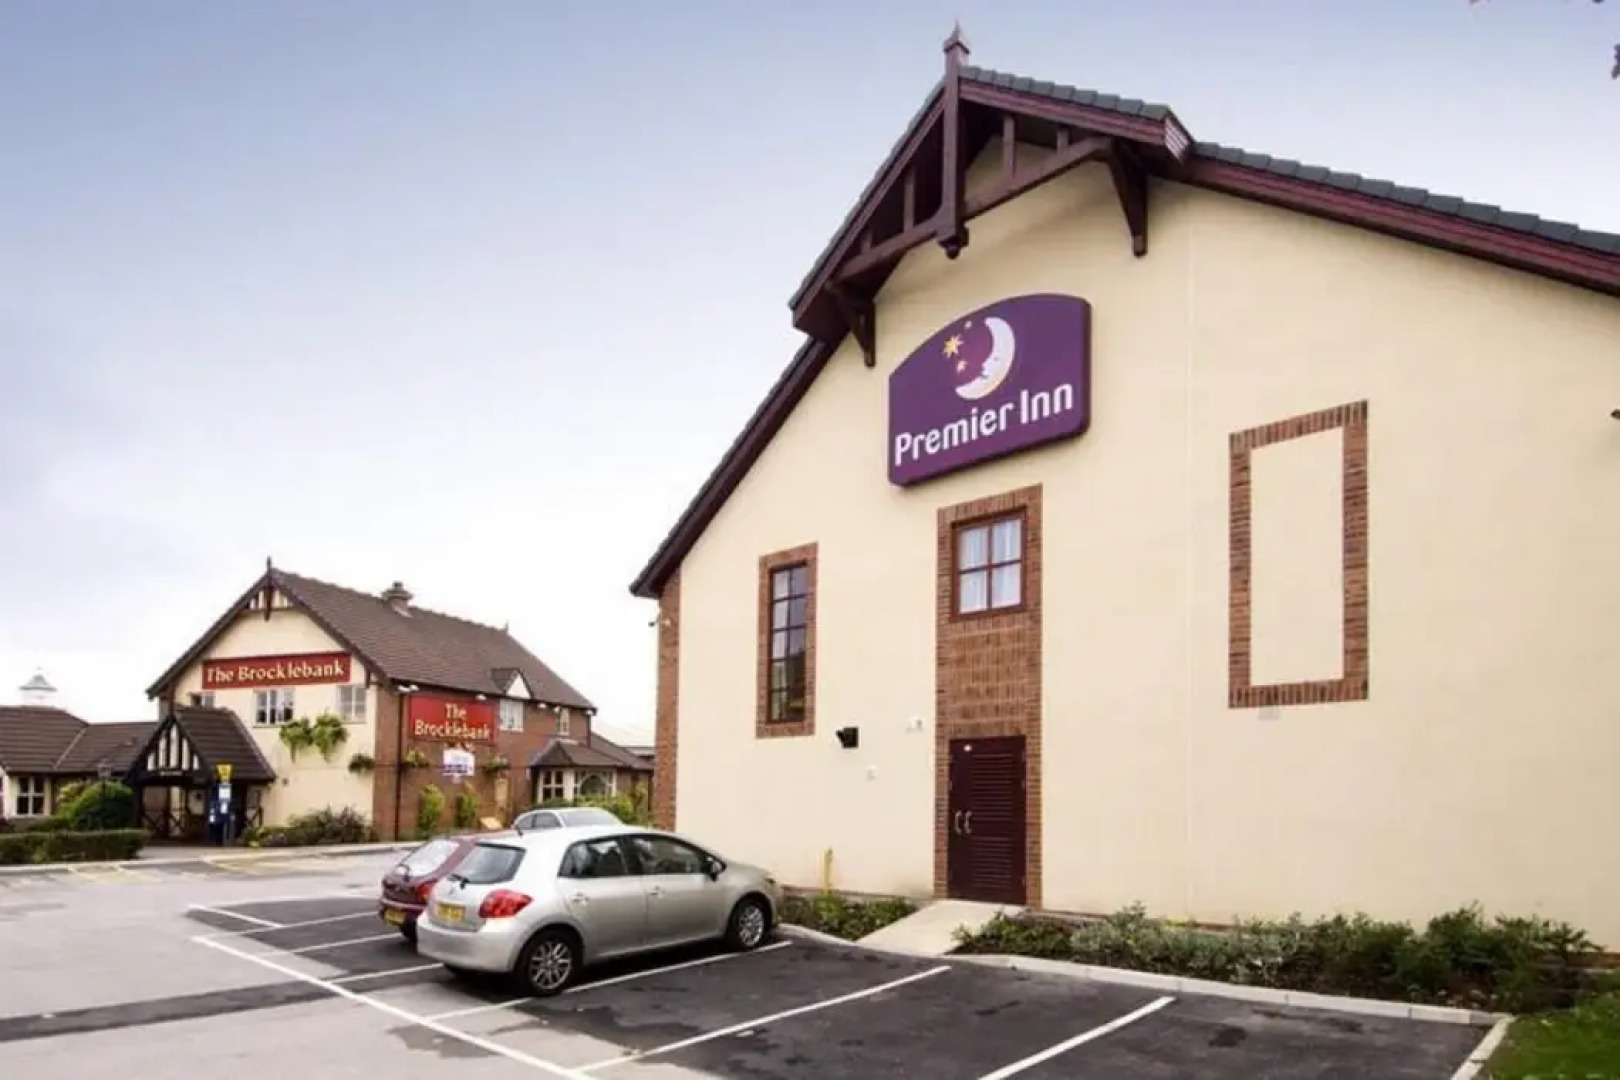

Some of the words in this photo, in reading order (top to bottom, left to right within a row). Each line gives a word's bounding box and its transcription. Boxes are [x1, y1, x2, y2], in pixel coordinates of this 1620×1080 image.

[895, 402, 1014, 466] Premier
[1020, 383, 1073, 424] Inn
[207, 667, 233, 682] The
[238, 660, 344, 681] Brocklebank
[445, 703, 467, 719] The
[415, 719, 490, 739] Brocklebank
